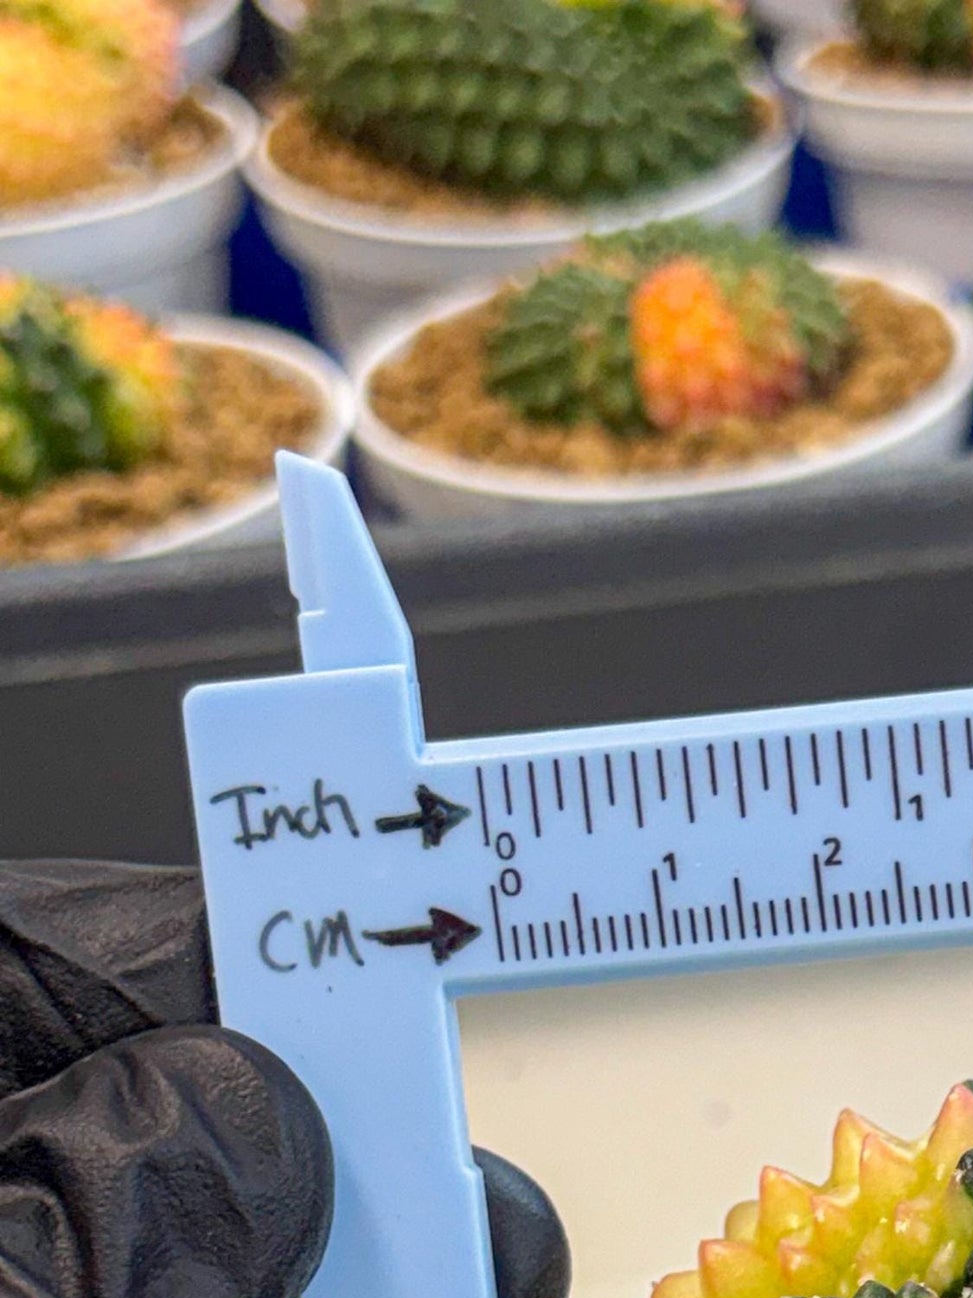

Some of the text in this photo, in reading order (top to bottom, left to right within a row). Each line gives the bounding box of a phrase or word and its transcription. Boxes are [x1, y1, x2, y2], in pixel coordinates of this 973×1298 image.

[209, 779, 360, 850] Inch
[495, 832, 517, 860] 0
[908, 794, 924, 822] 1
[501, 868, 522, 897] 0
[662, 853, 678, 882] 1
[823, 838, 842, 866] 2
